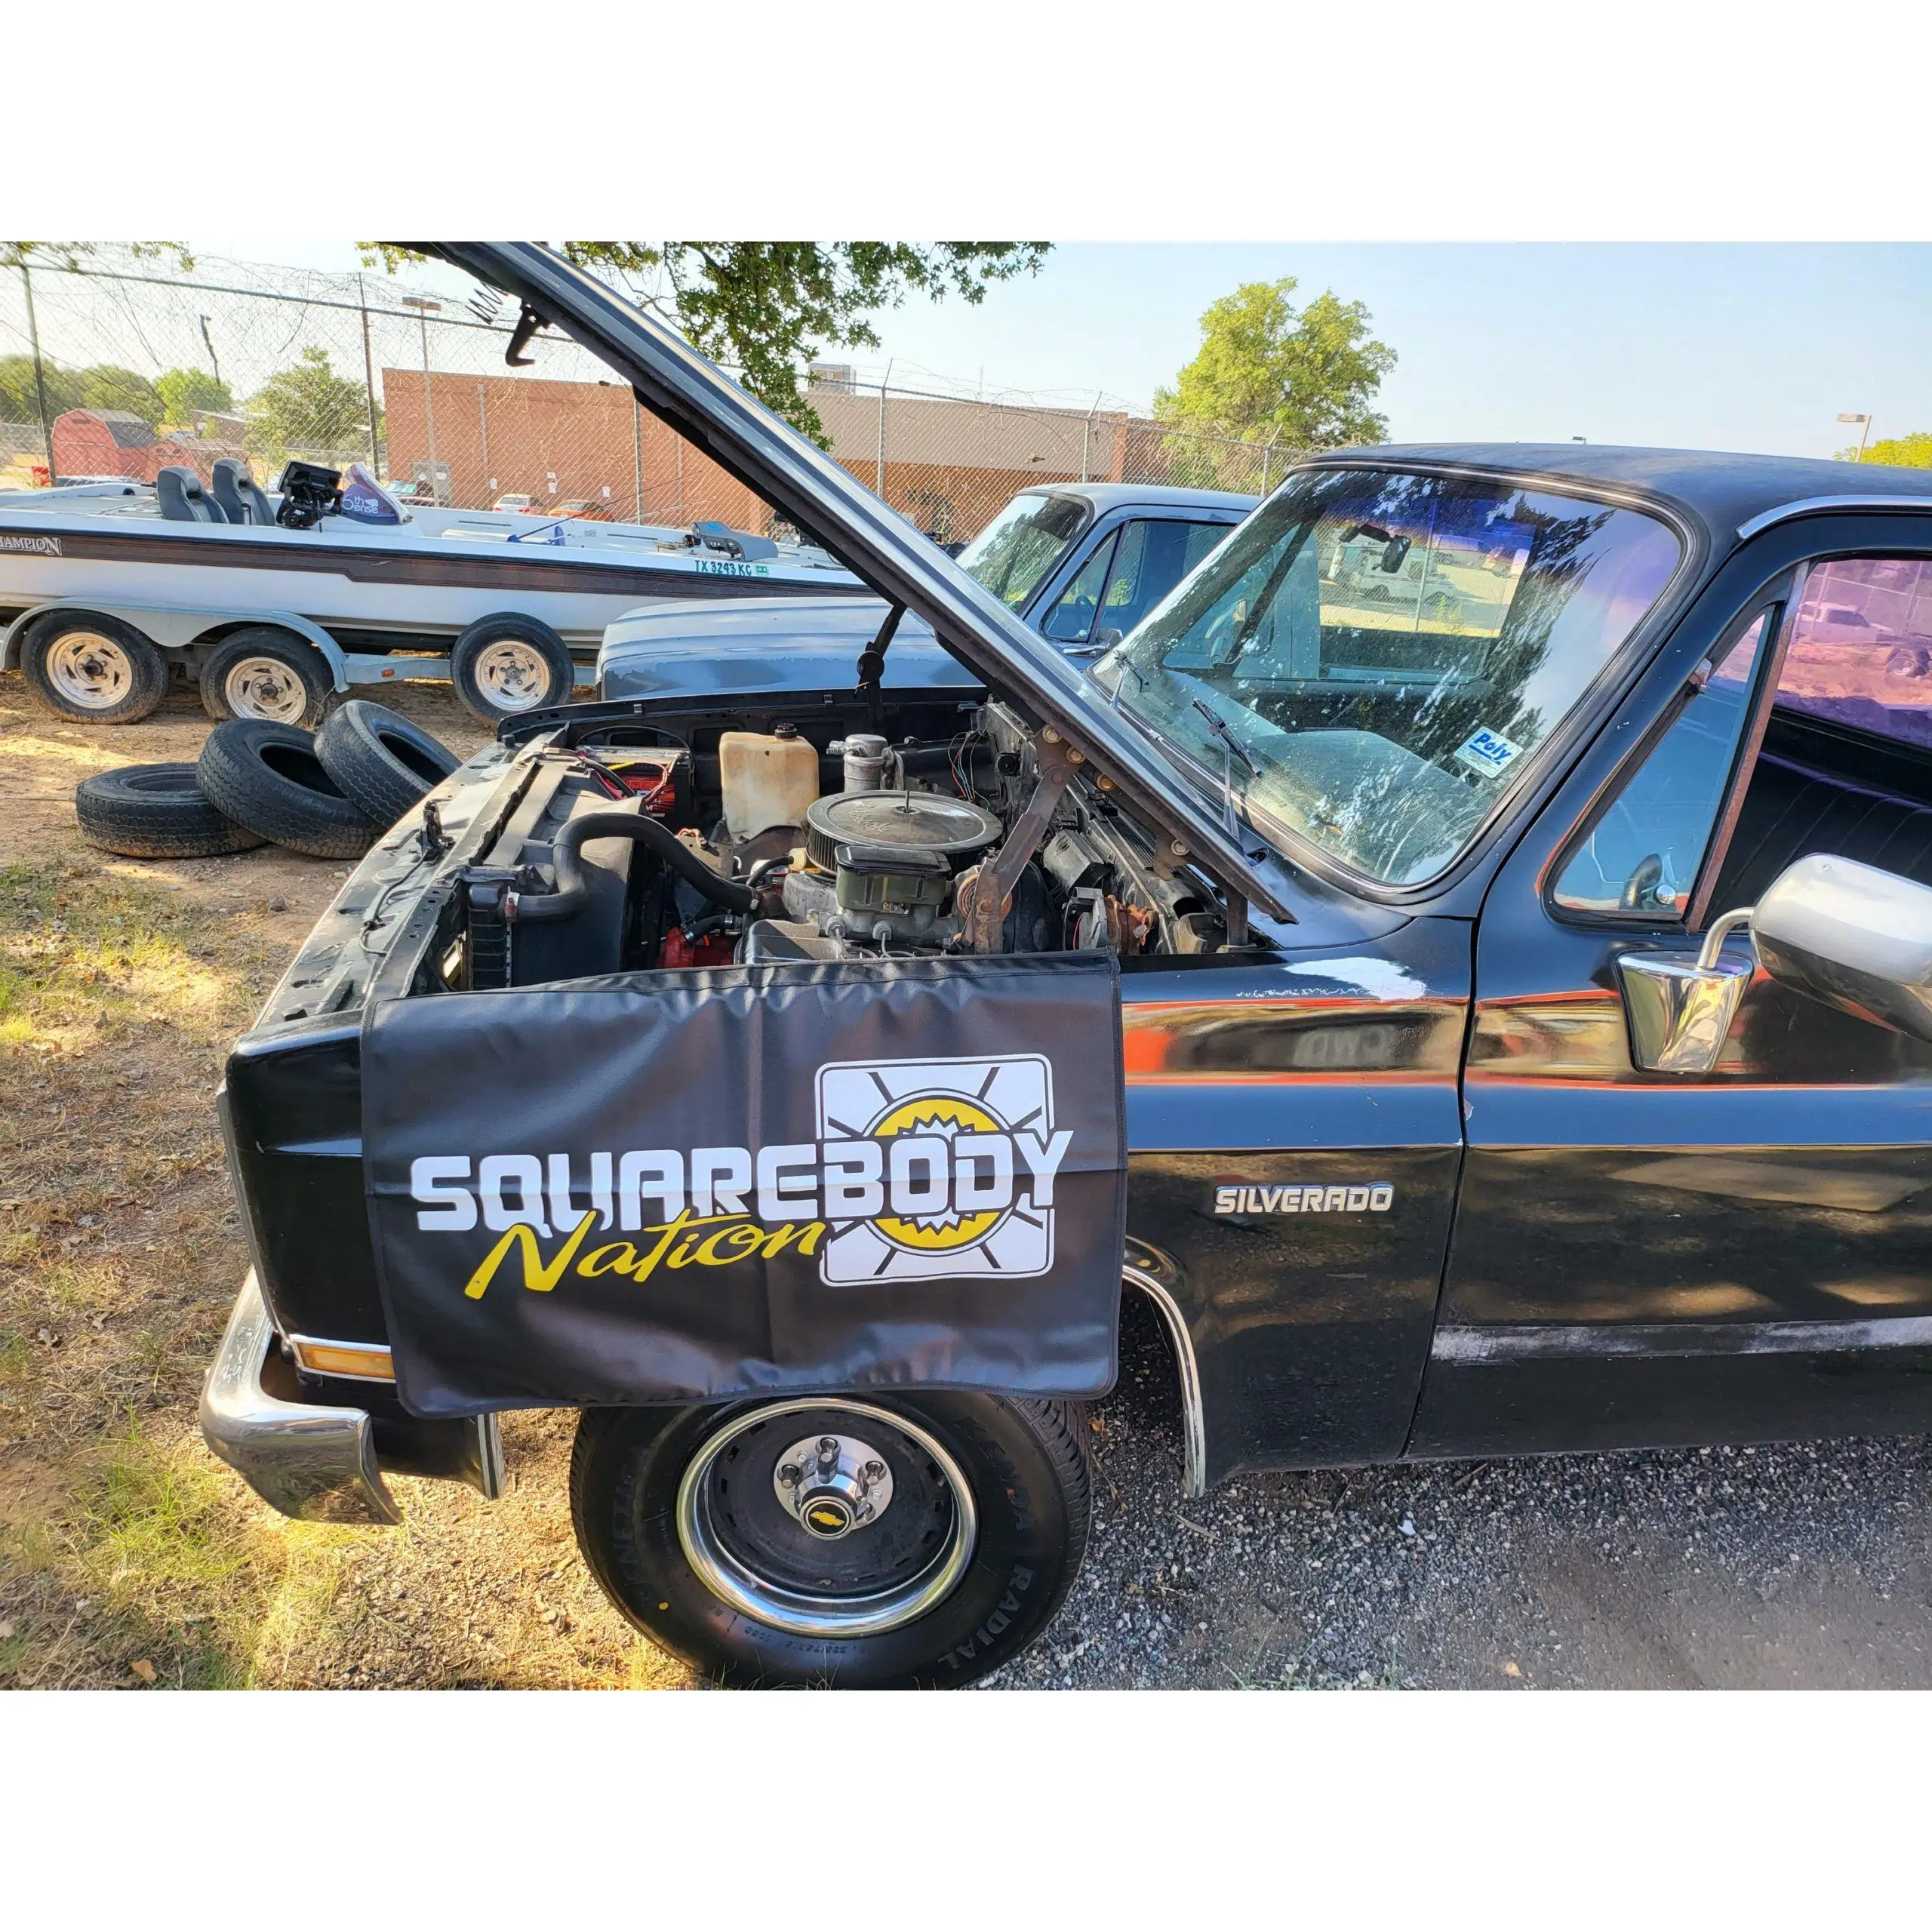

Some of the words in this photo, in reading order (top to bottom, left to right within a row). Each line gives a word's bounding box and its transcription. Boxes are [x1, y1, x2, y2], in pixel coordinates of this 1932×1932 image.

[695, 560, 708, 572] TX
[710, 561, 736, 575] 3243
[1473, 733, 1512, 761] Poly
[411, 1131, 1073, 1238] SQUAREBODY
[1214, 1181, 1395, 1214] SILVERADO
[464, 1208, 825, 1300] Nation
[937, 1564, 1035, 1669] RADIAL
